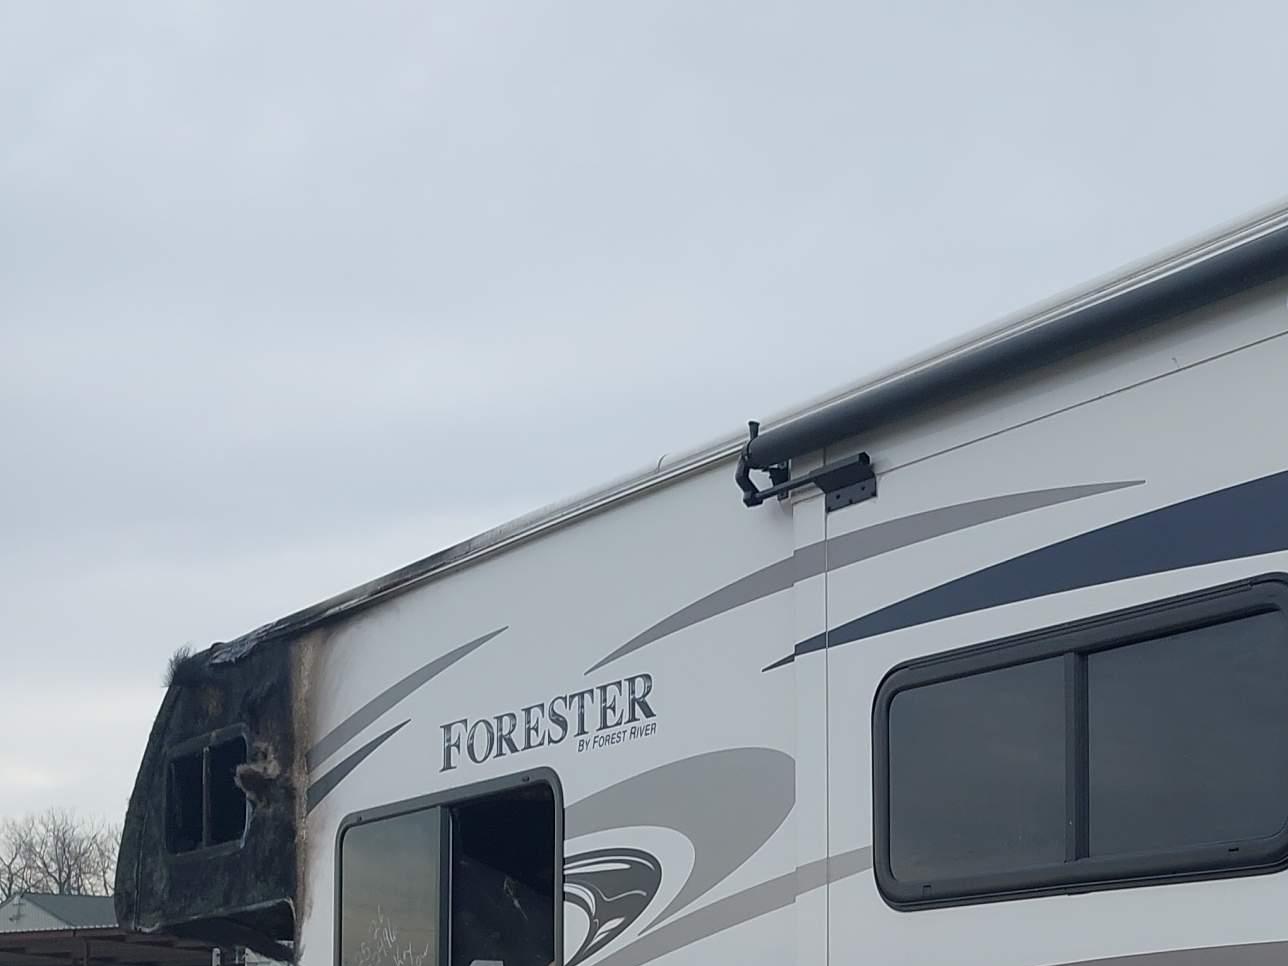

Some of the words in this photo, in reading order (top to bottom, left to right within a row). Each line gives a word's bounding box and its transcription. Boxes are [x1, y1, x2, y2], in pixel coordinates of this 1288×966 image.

[439, 673, 656, 772] FORESTER
[577, 736, 590, 752] BY
[592, 730, 629, 749] FOREST
[629, 722, 657, 742] RIVER
